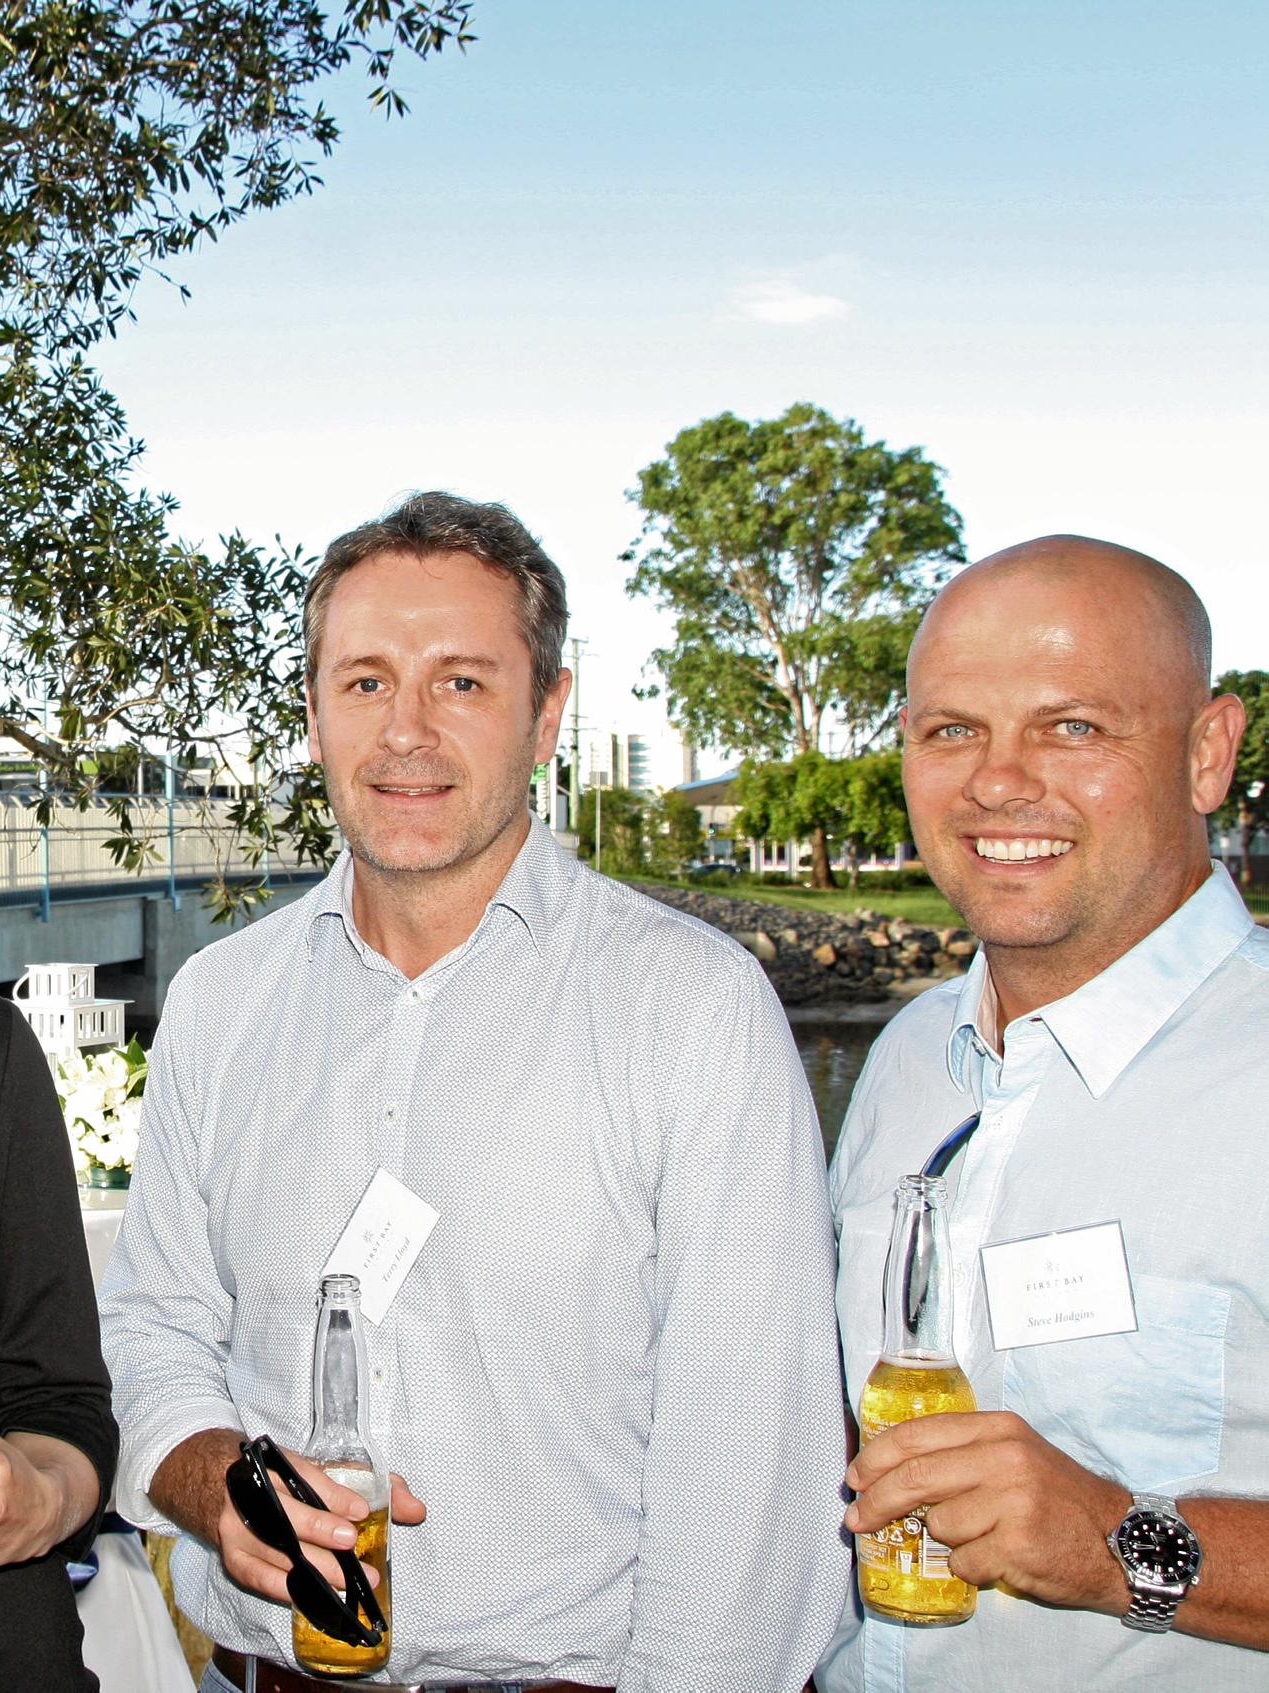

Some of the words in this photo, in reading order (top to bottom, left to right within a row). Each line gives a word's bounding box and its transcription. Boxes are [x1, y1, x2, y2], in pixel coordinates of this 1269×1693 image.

[1026, 1280, 1059, 1291] FIRST
[1064, 1275, 1084, 1286] BAY
[1027, 1316, 1052, 1328] Steve
[1055, 1310, 1095, 1324] Hodgins
